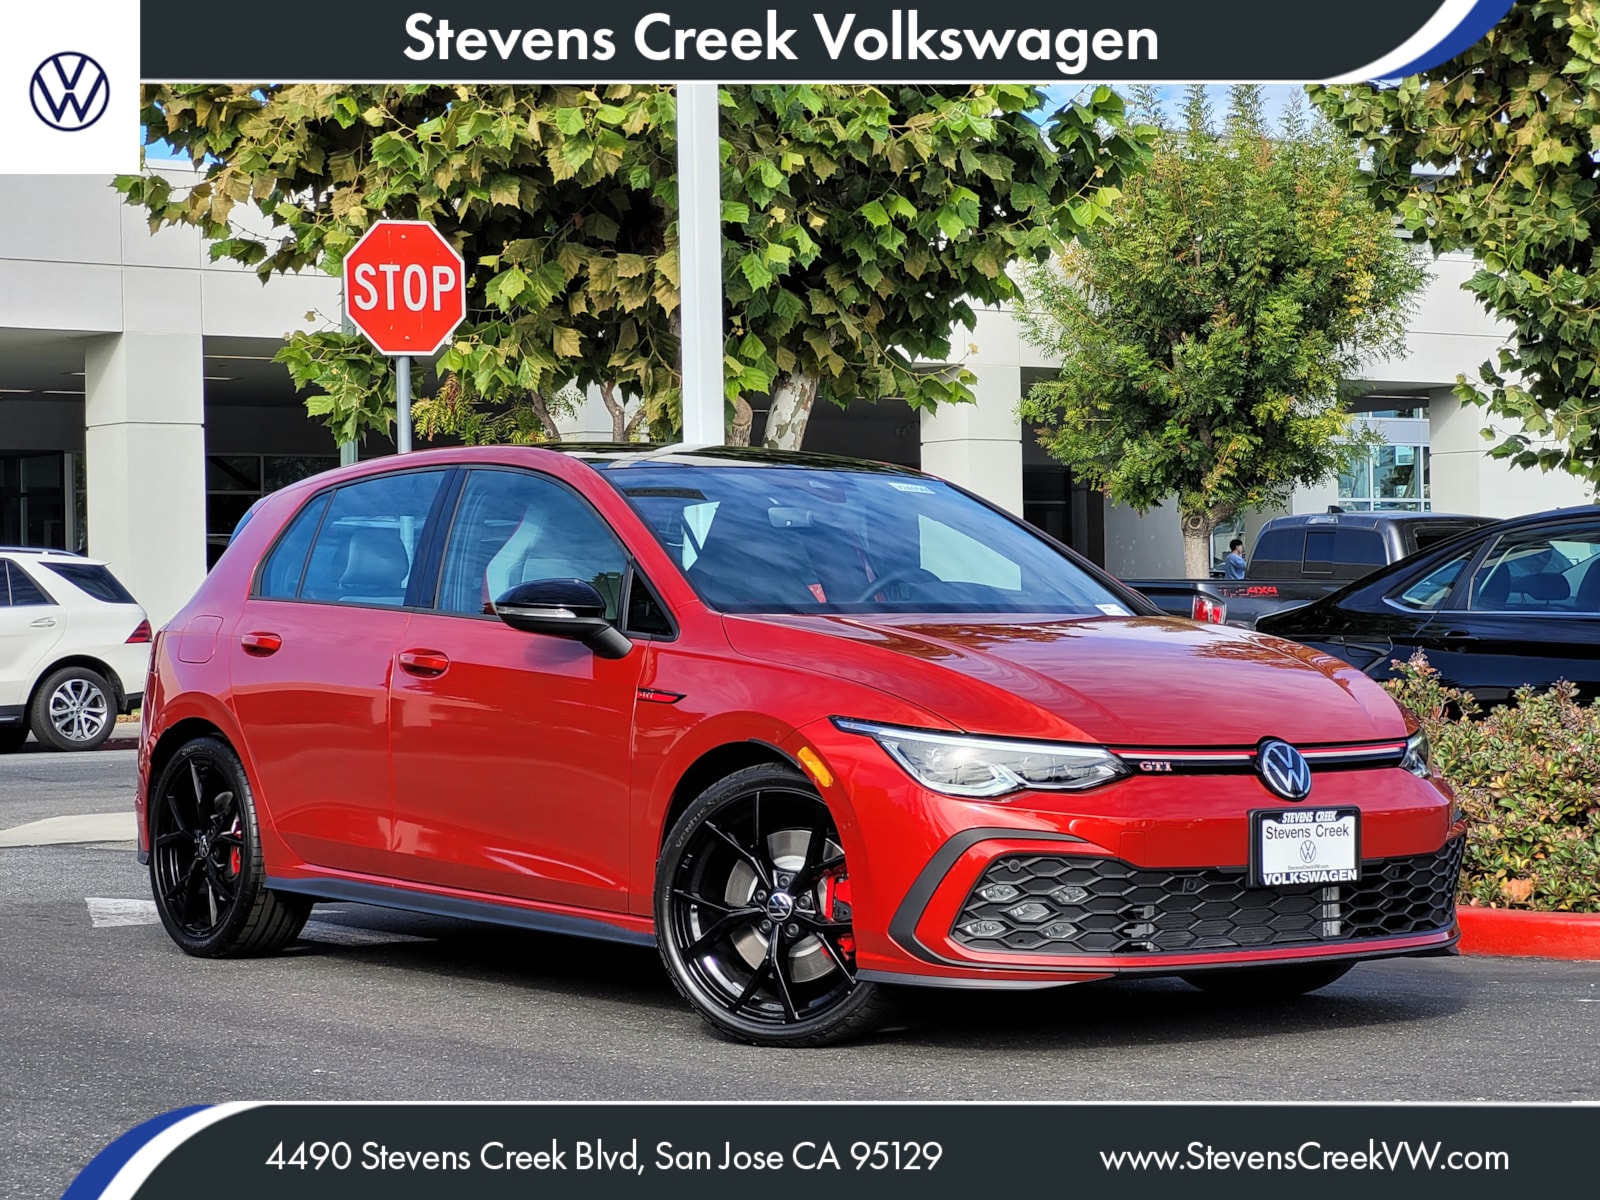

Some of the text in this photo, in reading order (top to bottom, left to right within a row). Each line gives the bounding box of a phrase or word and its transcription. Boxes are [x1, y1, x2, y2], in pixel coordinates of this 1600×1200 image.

[354, 263, 456, 312] STOP
[1139, 761, 1172, 772] GTI
[1282, 811, 1338, 824] STEVENS CREEK
[1265, 824, 1349, 840] Stevens Creek
[1263, 869, 1357, 886] VOLKSWAGEN
